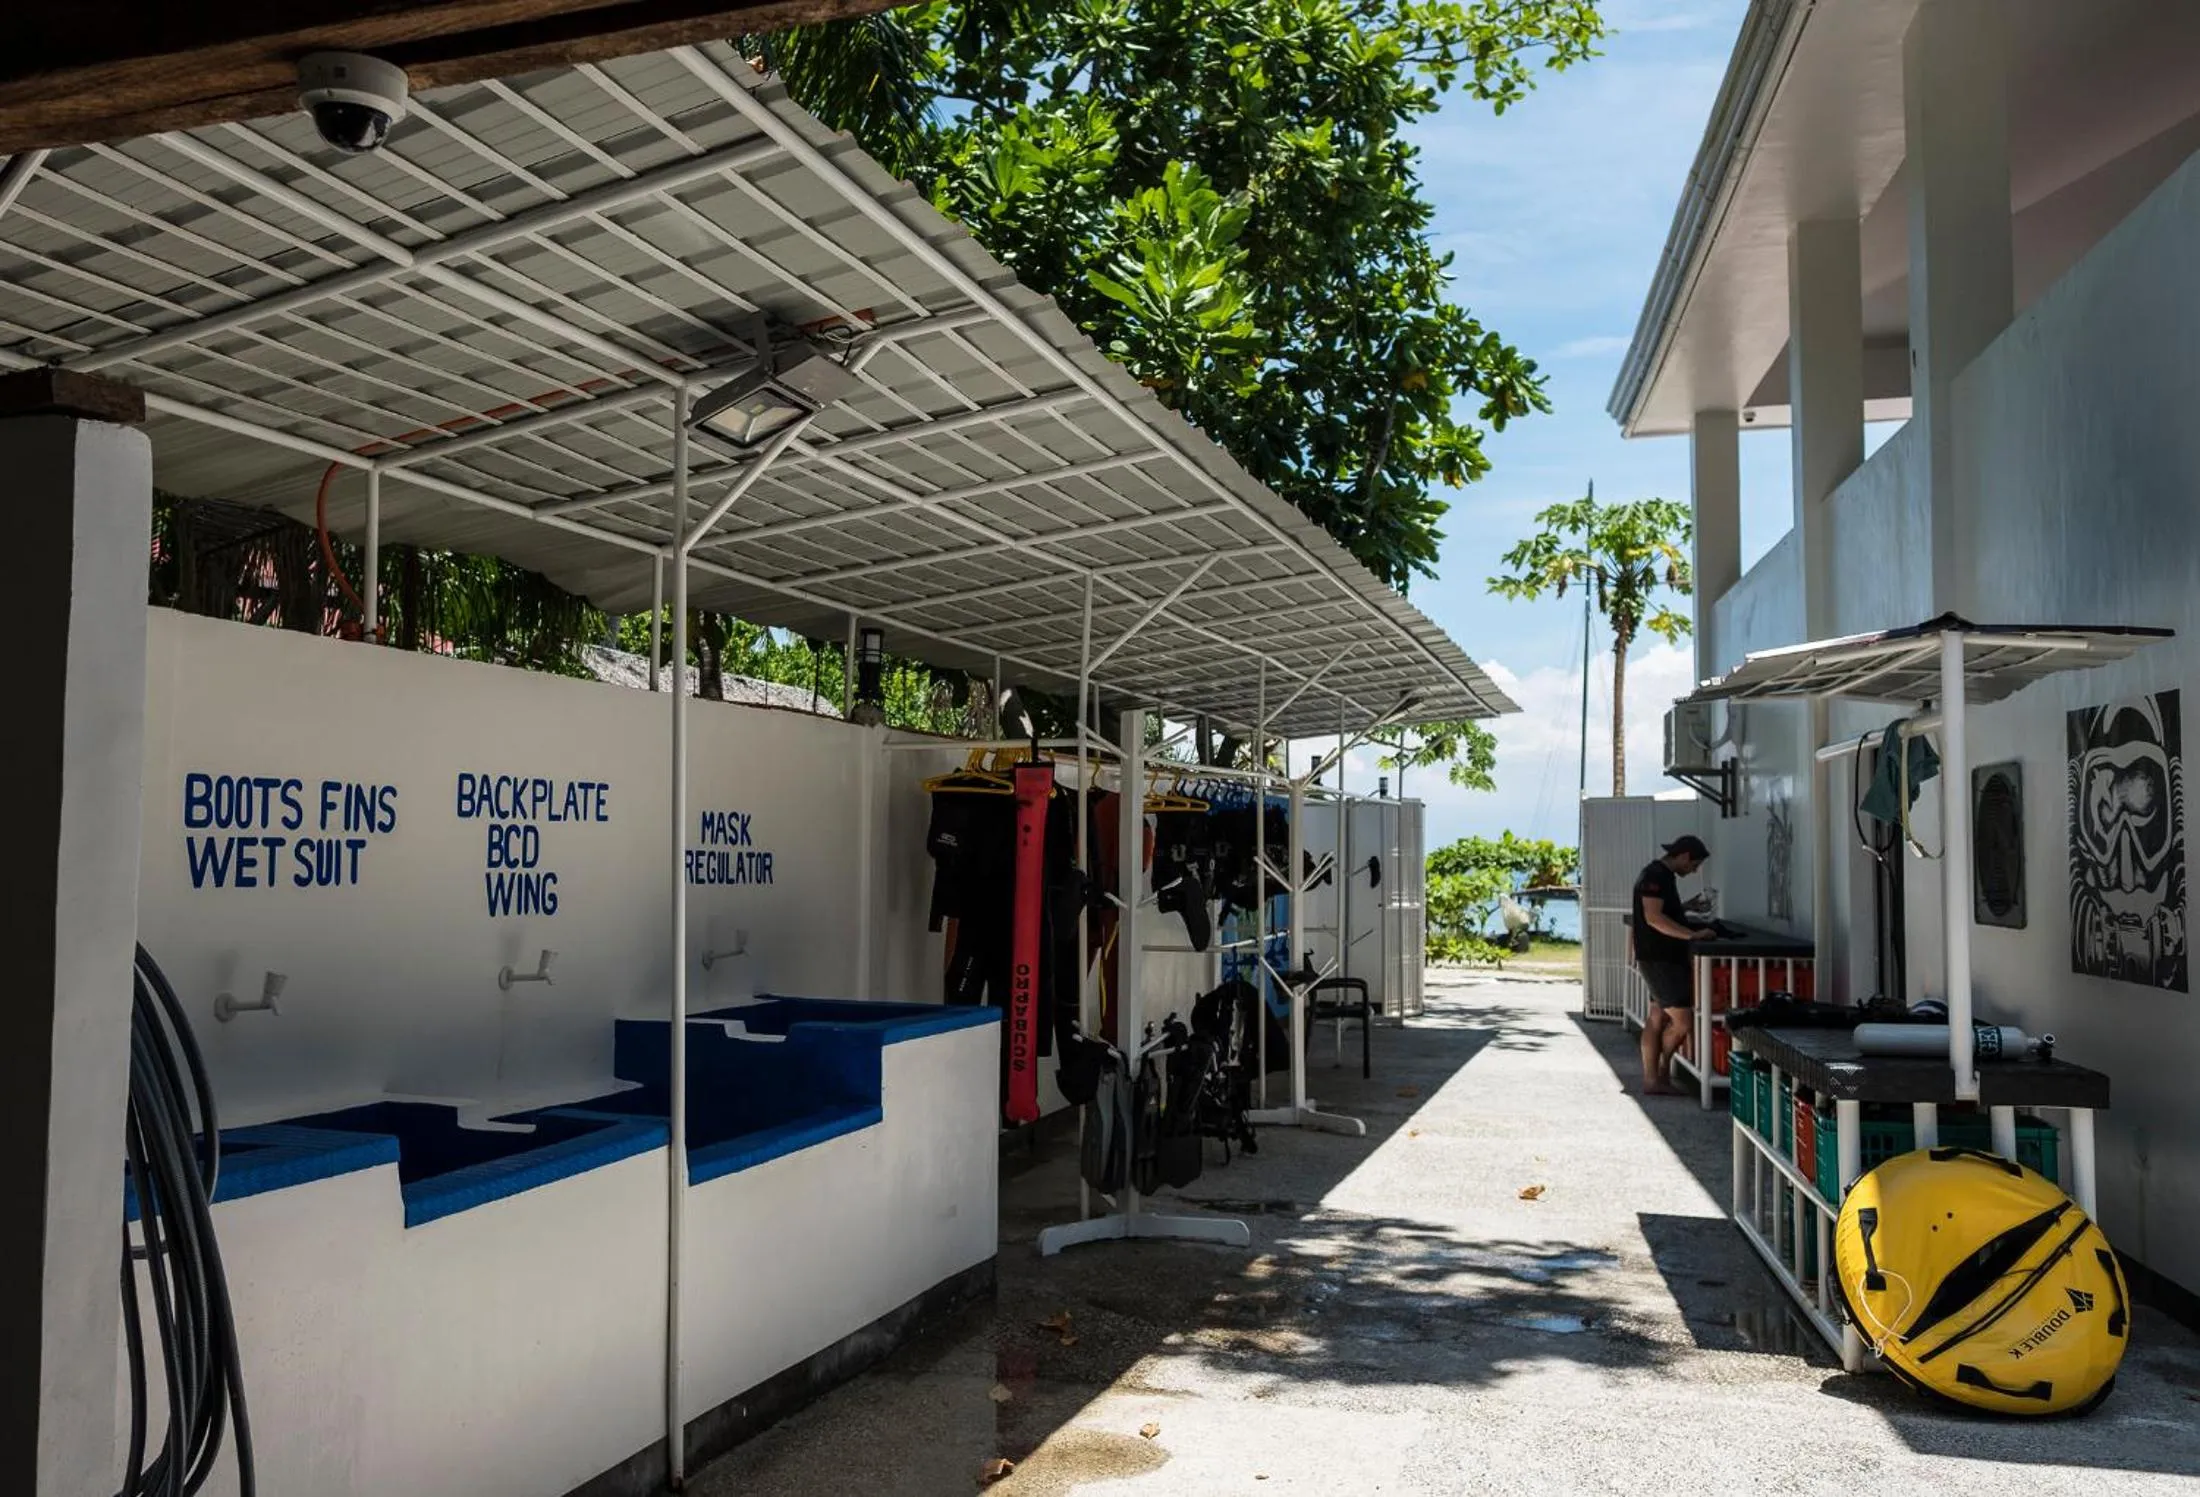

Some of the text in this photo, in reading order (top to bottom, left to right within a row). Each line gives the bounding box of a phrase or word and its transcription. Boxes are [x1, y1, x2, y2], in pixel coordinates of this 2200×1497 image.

[184, 773, 398, 833] BOOTS FINS
[457, 773, 609, 822] BACKPLATE
[487, 824, 539, 869] BCD
[701, 811, 752, 846] MASK
[186, 836, 367, 889] WET SUIT
[685, 850, 774, 885] REGULATOR
[485, 872, 558, 918] WING
[1013, 963, 1030, 1072] SCUBAPRO
[2020, 1309, 2071, 1352] DOUBLE
